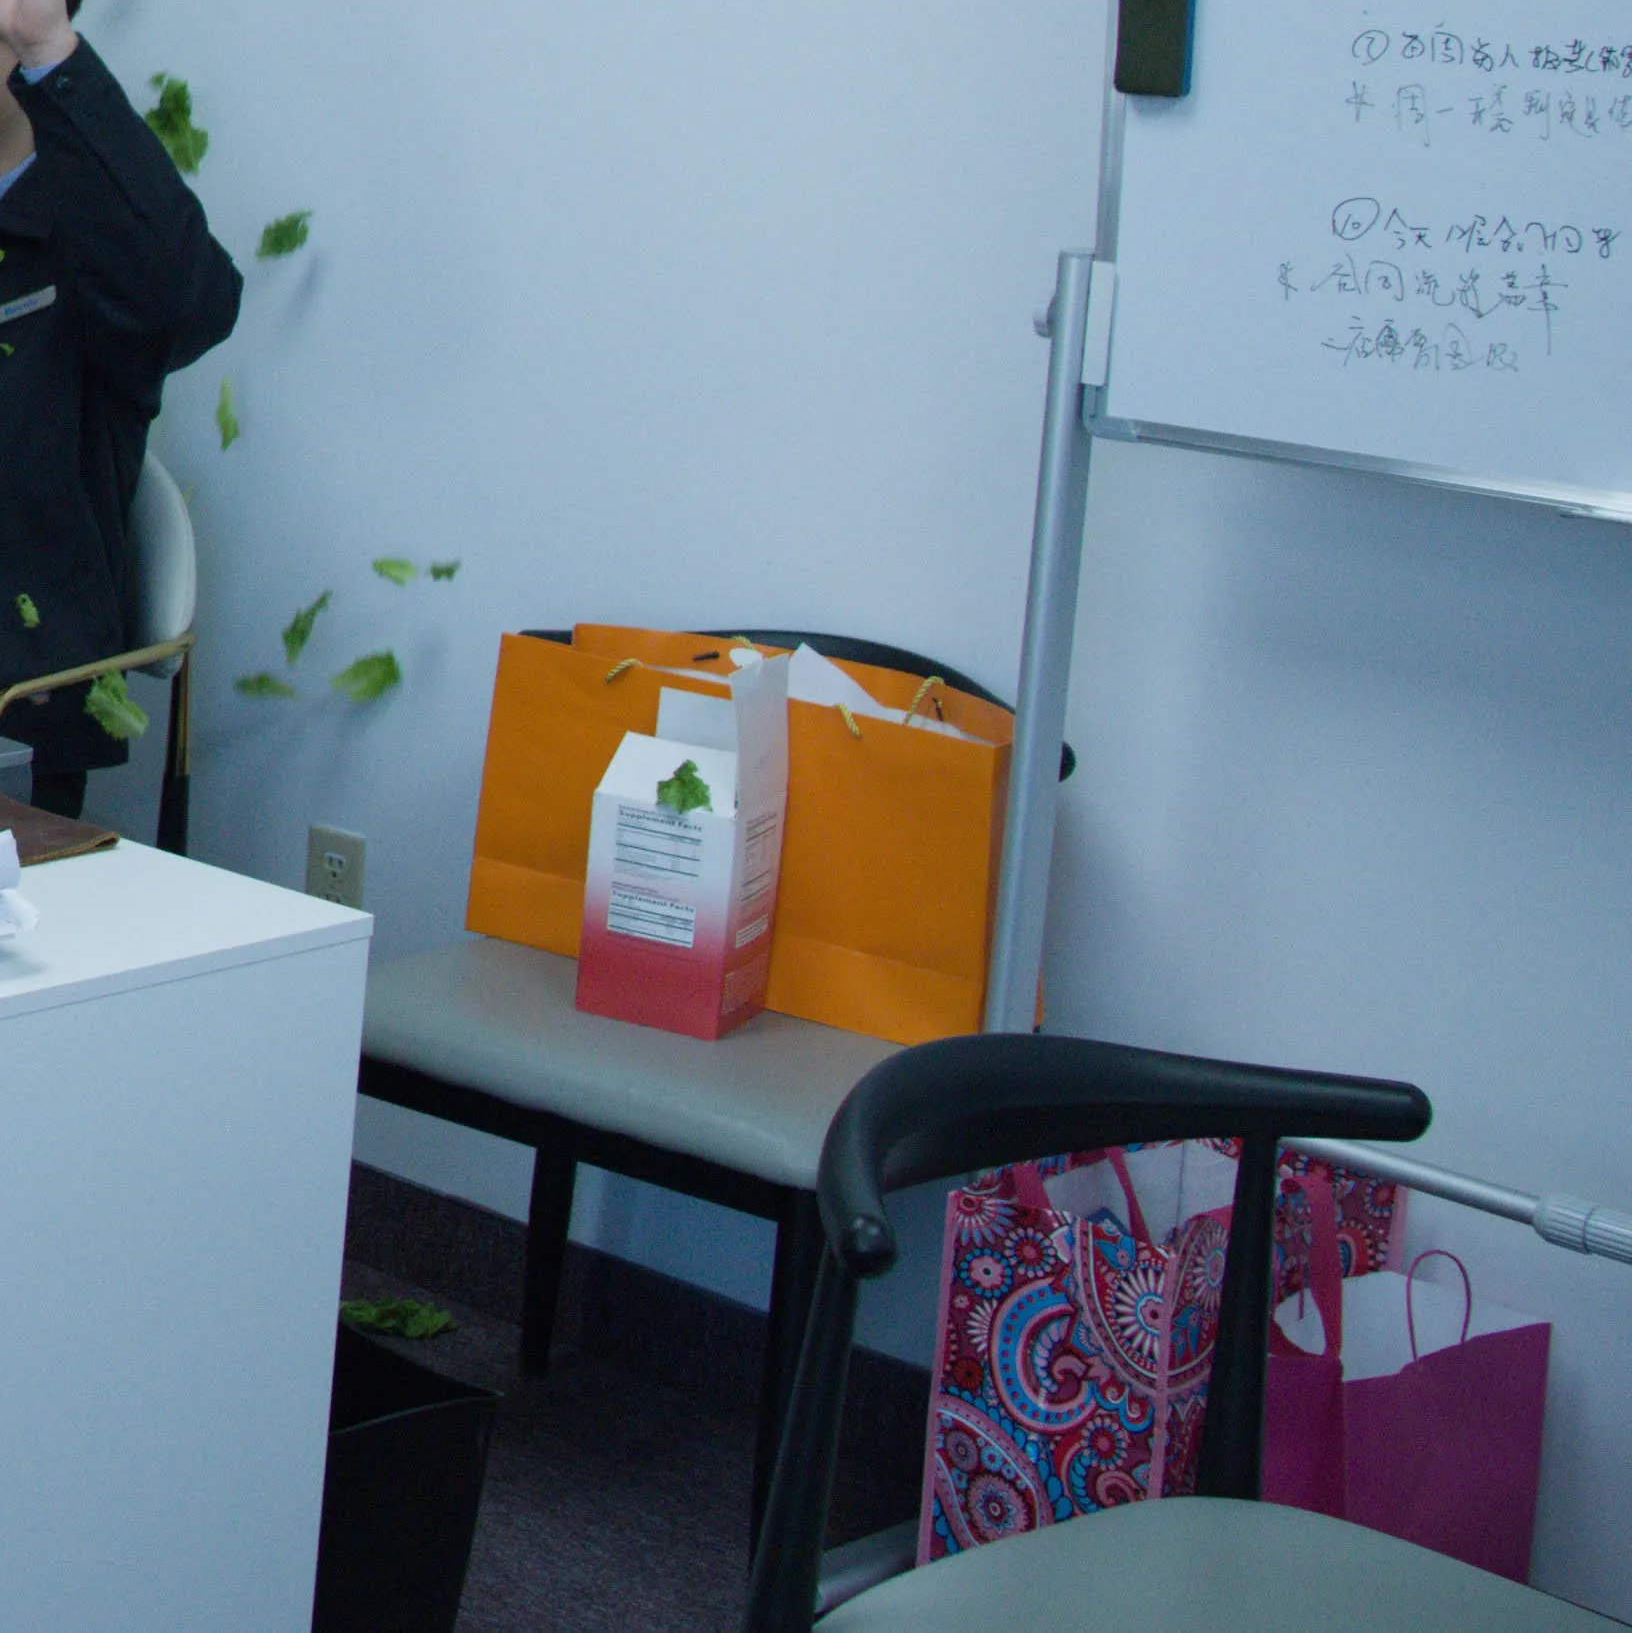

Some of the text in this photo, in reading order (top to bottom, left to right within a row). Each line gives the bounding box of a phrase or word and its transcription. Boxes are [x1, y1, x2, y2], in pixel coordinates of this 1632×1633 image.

[619, 810, 703, 832] Supplement Facts
[612, 890, 695, 913] Supplement Facts
